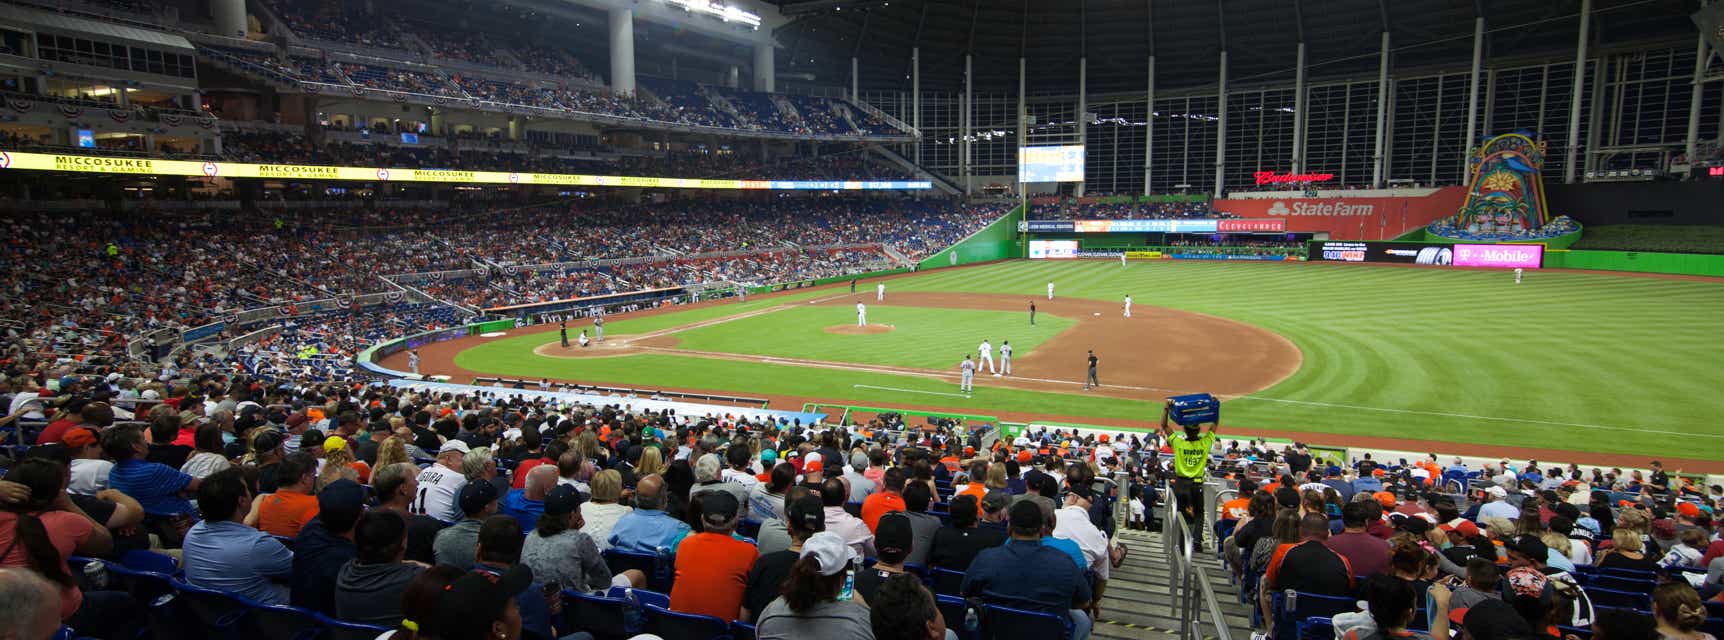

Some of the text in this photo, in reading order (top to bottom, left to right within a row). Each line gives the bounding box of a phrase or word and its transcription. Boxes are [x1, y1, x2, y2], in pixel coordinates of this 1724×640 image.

[55, 156, 153, 168] MICCOSUKEE
[259, 165, 338, 174] MICCOSUKEE
[414, 170, 475, 178] MICCOSUKEE
